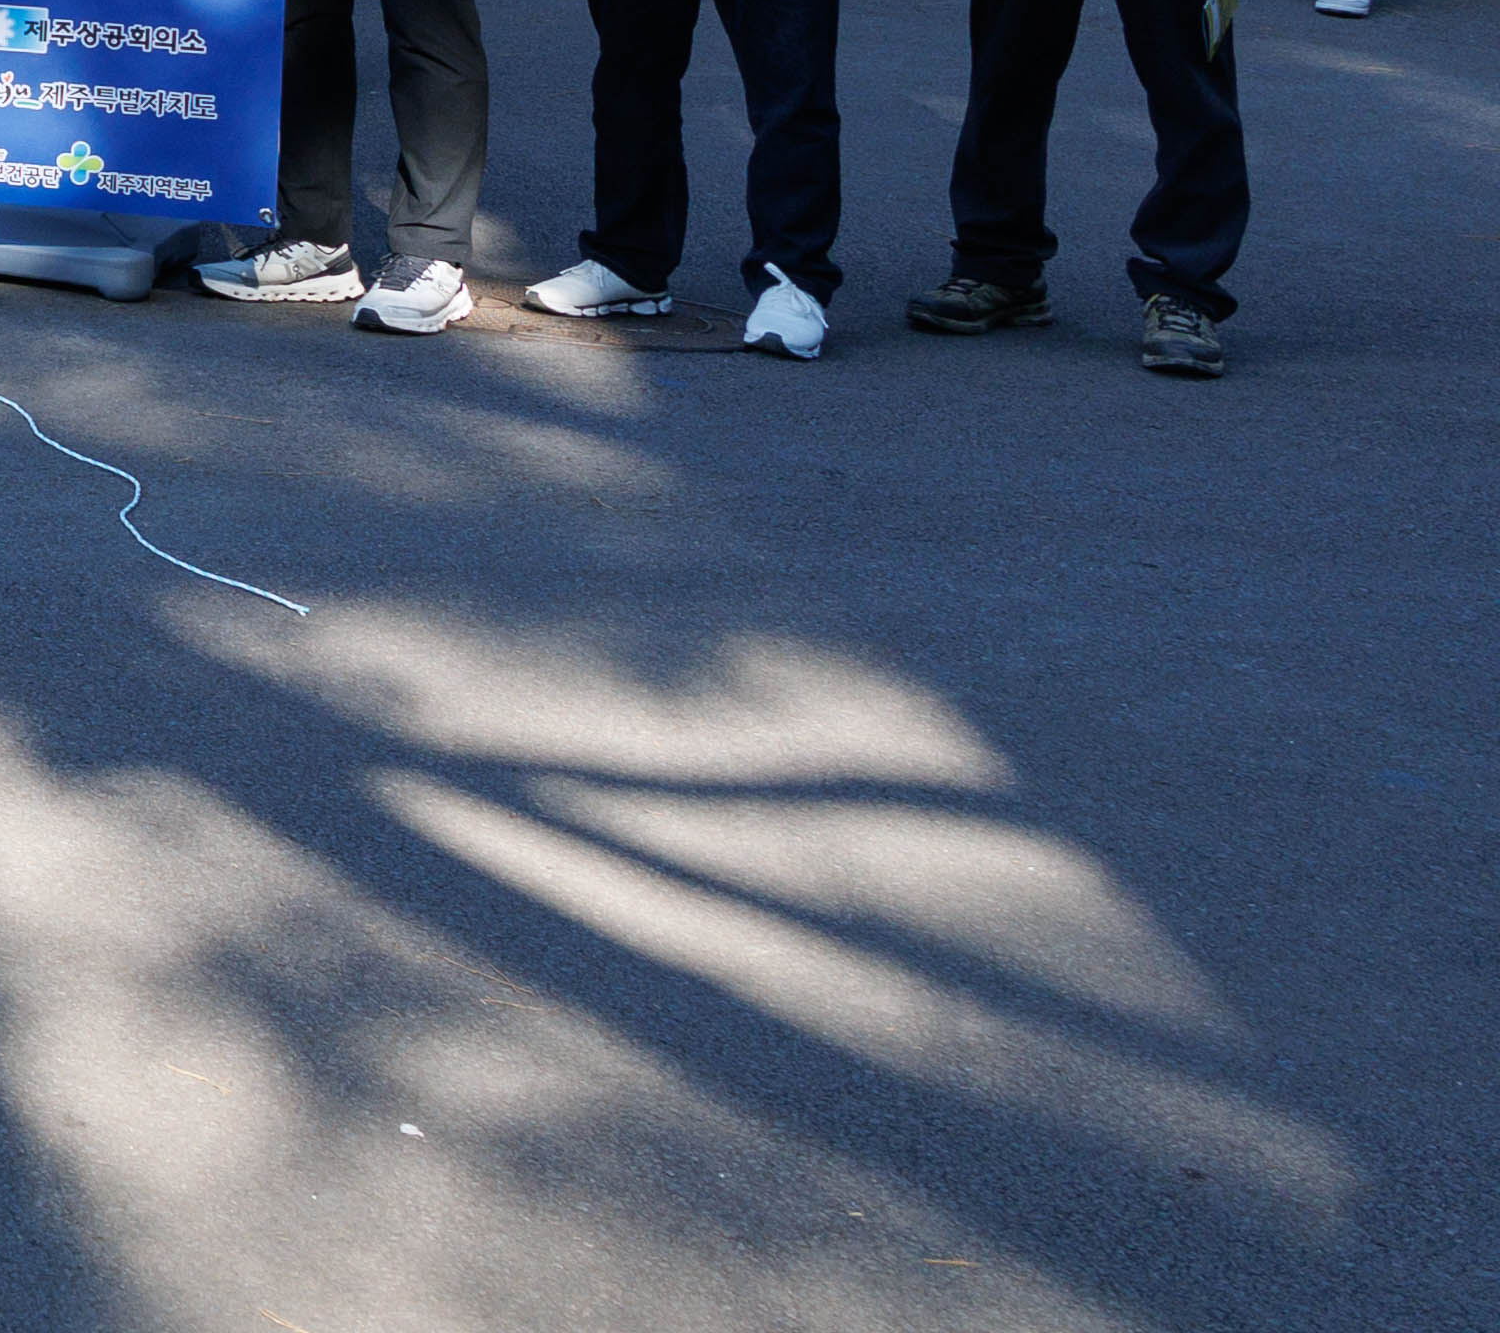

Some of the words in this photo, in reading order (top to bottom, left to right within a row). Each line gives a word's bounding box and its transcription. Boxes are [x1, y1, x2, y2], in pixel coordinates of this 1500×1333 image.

[24, 19, 207, 54] 제주상공회의소
[41, 81, 218, 120] 제주특별자치도
[98, 172, 213, 201] 제주지역본부
